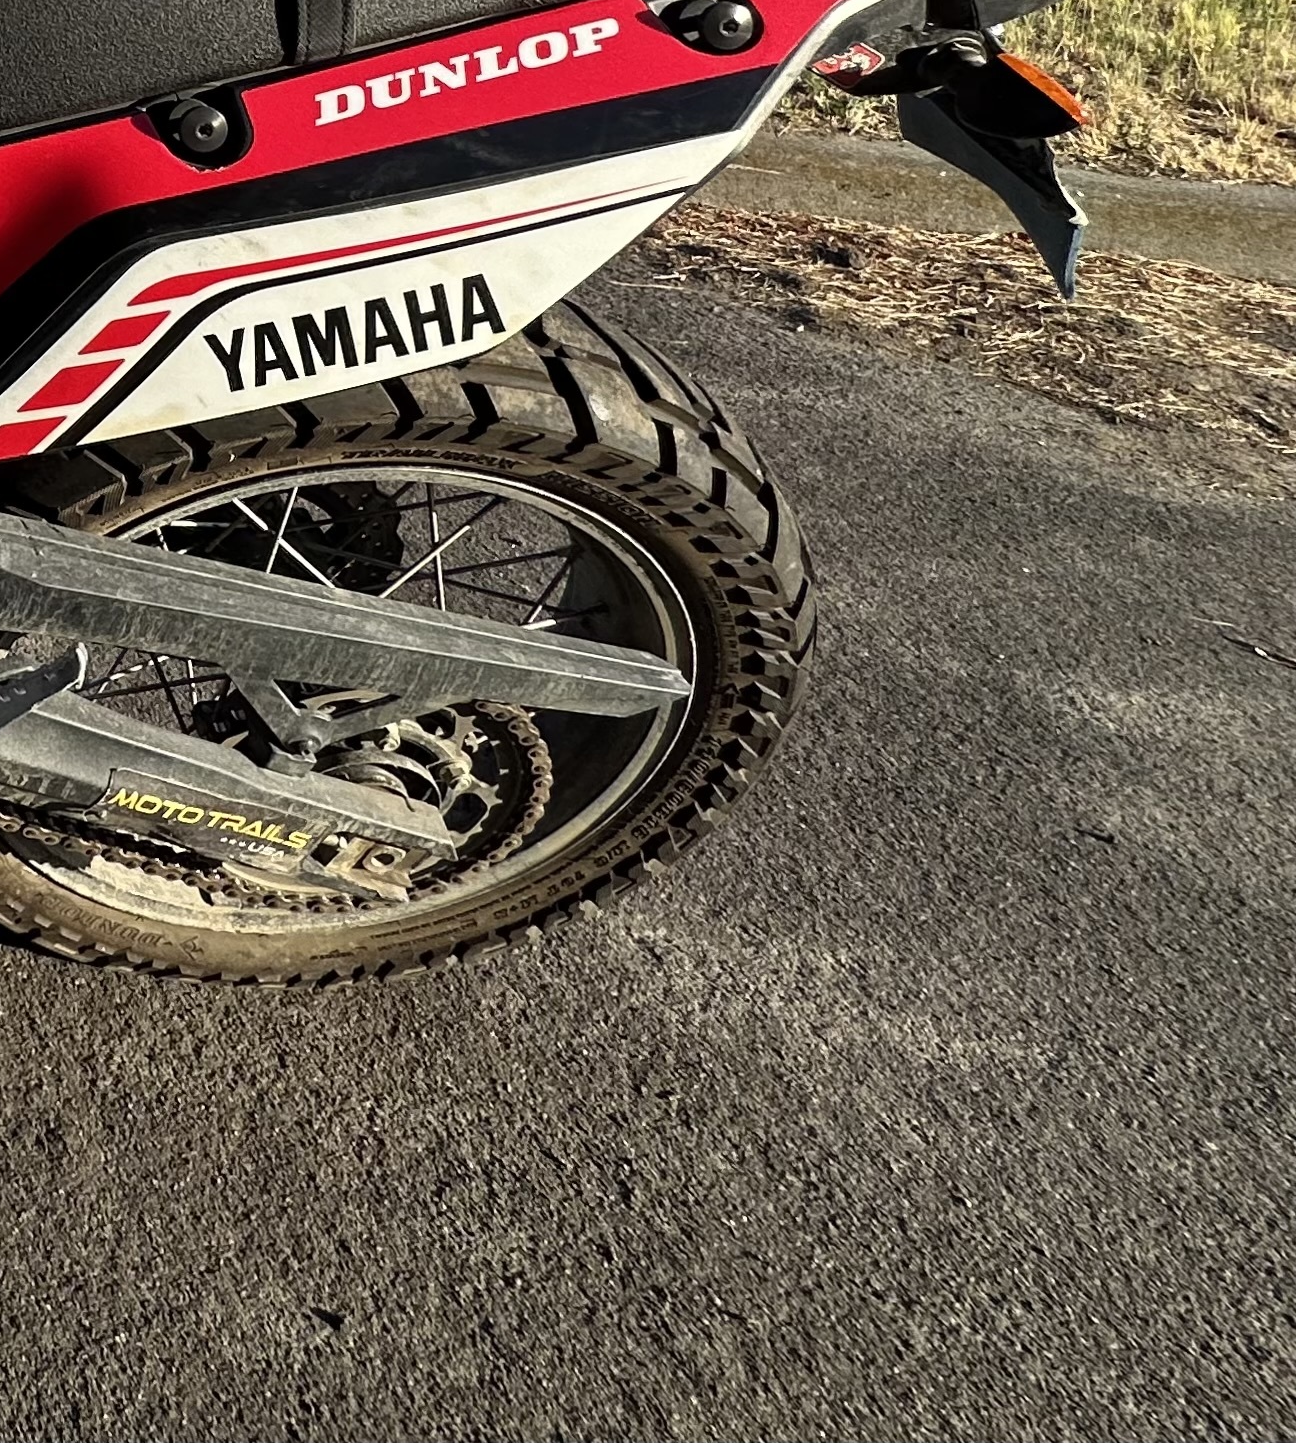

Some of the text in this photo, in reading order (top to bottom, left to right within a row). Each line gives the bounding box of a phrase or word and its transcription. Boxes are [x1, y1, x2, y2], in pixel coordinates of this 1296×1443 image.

[314, 18, 620, 127] DUNLOP
[203, 273, 507, 393] YAMAHA
[109, 787, 313, 849] MOTO TRAILS
[247, 841, 285, 860] USA
